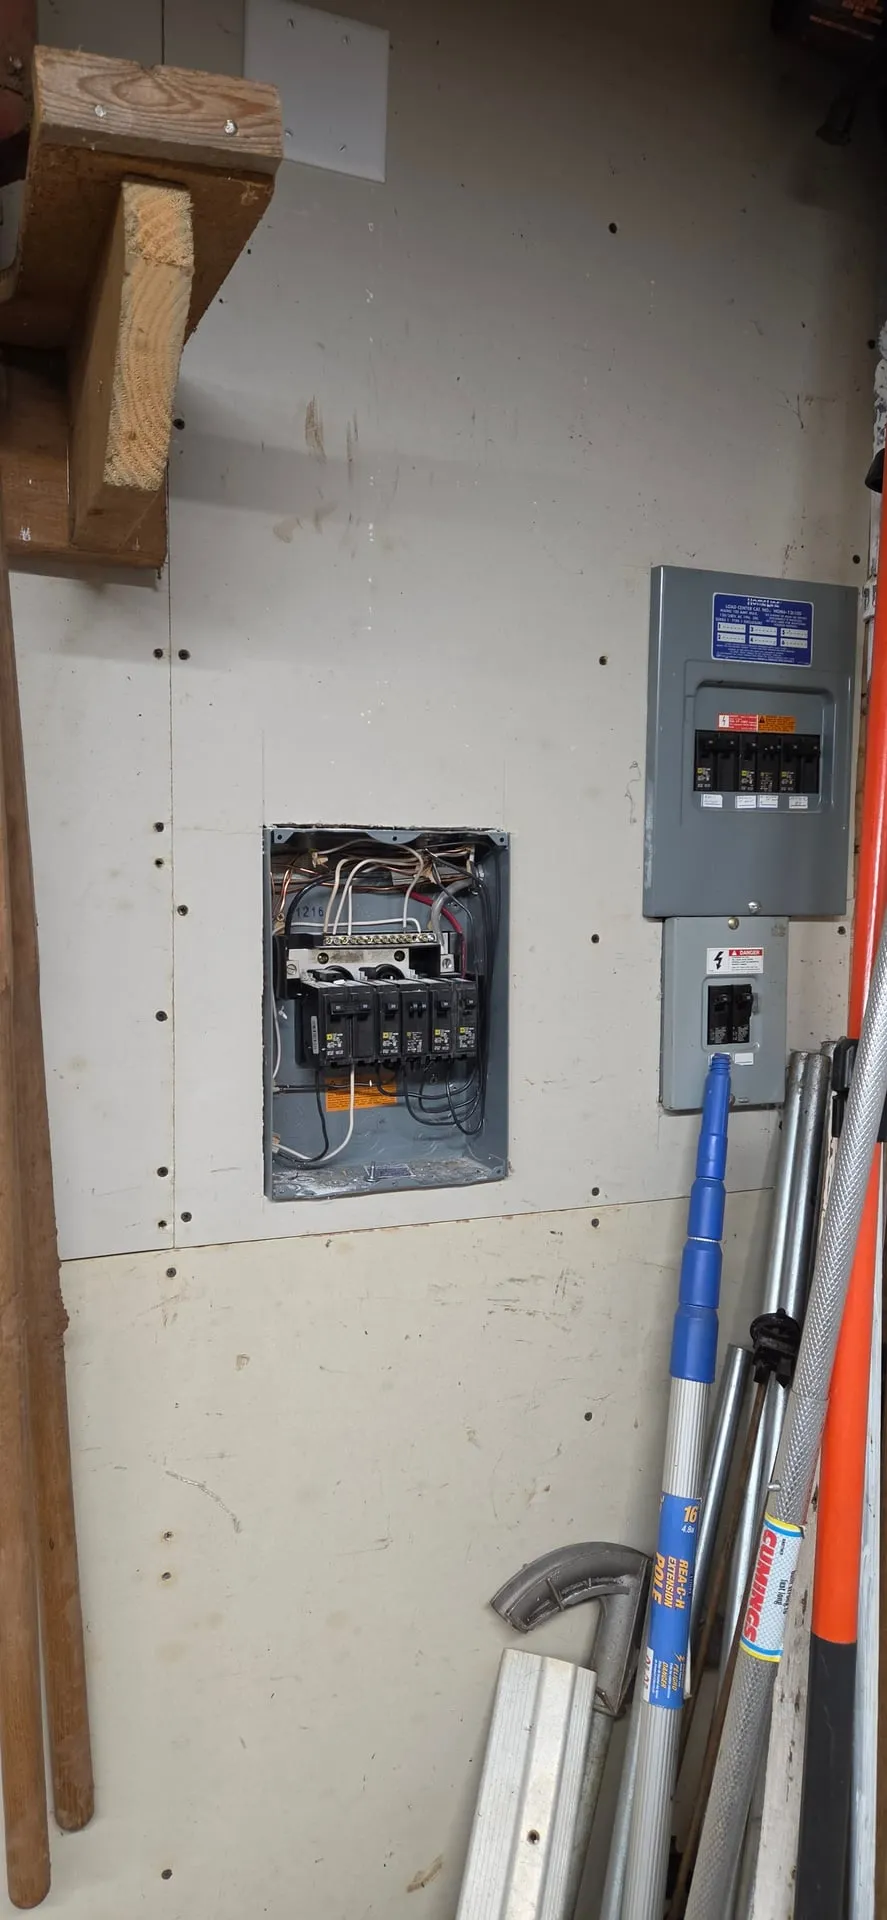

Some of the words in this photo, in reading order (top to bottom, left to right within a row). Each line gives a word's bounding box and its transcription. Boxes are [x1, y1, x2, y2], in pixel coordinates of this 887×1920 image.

[296, 906, 324, 918] 1216
[652, 1551, 666, 1605] POLE
[664, 1555, 677, 1609] EXTENSION
[675, 1558, 689, 1609] REA-C-H
[743, 1529, 778, 1643] CUMINGS
[660, 1661, 669, 1689] DANGER
[671, 1664, 680, 1692] PELIGRO
